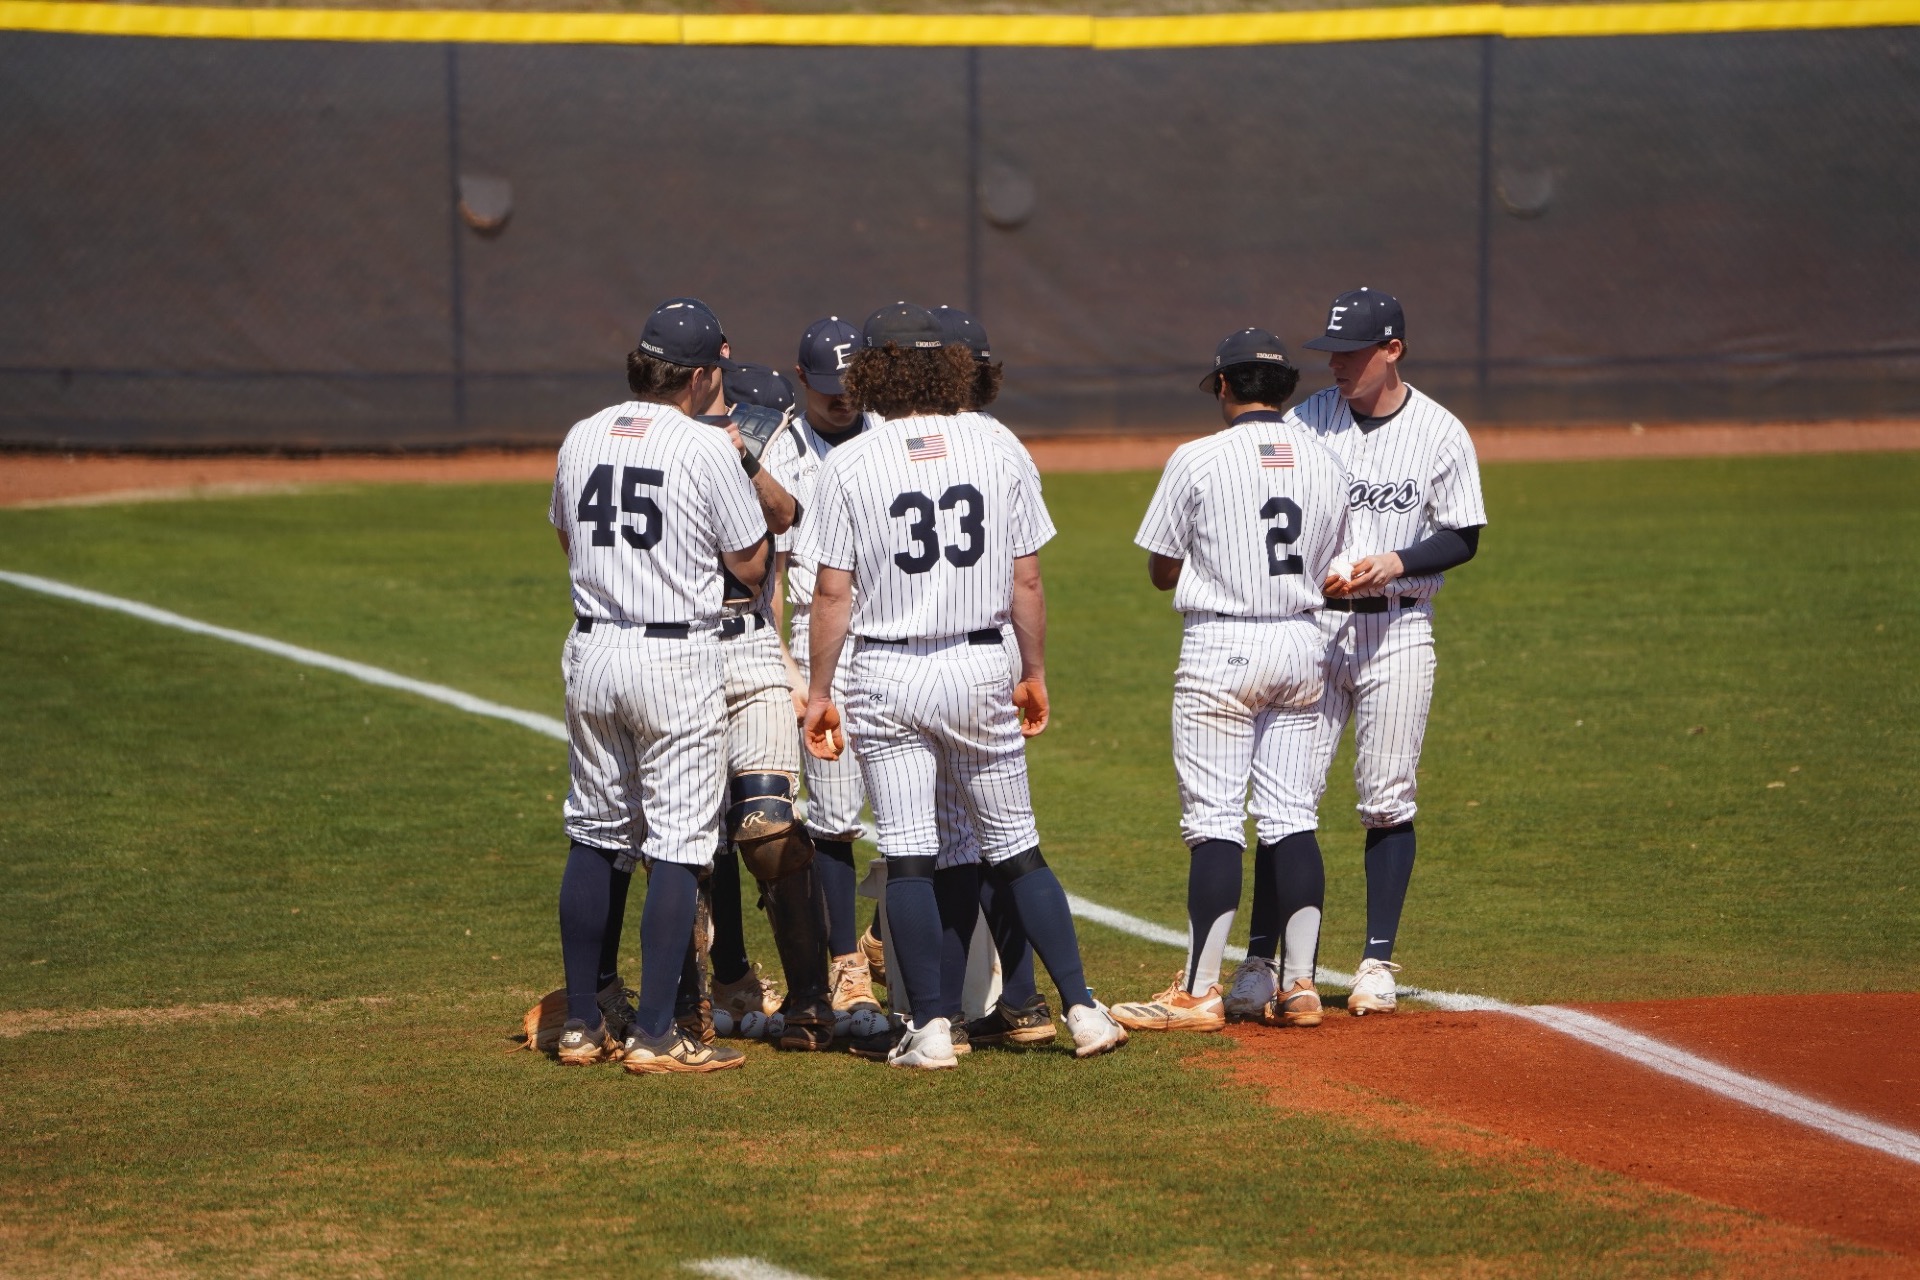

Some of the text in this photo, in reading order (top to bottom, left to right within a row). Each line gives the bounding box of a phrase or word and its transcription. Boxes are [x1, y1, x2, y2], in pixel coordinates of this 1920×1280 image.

[1327, 306, 1348, 331] E
[833, 343, 852, 371] E
[577, 463, 664, 550] 45
[1347, 472, 1420, 514] ons
[889, 484, 985, 575] 33
[1260, 496, 1304, 577] 2
[741, 810, 768, 829] R
